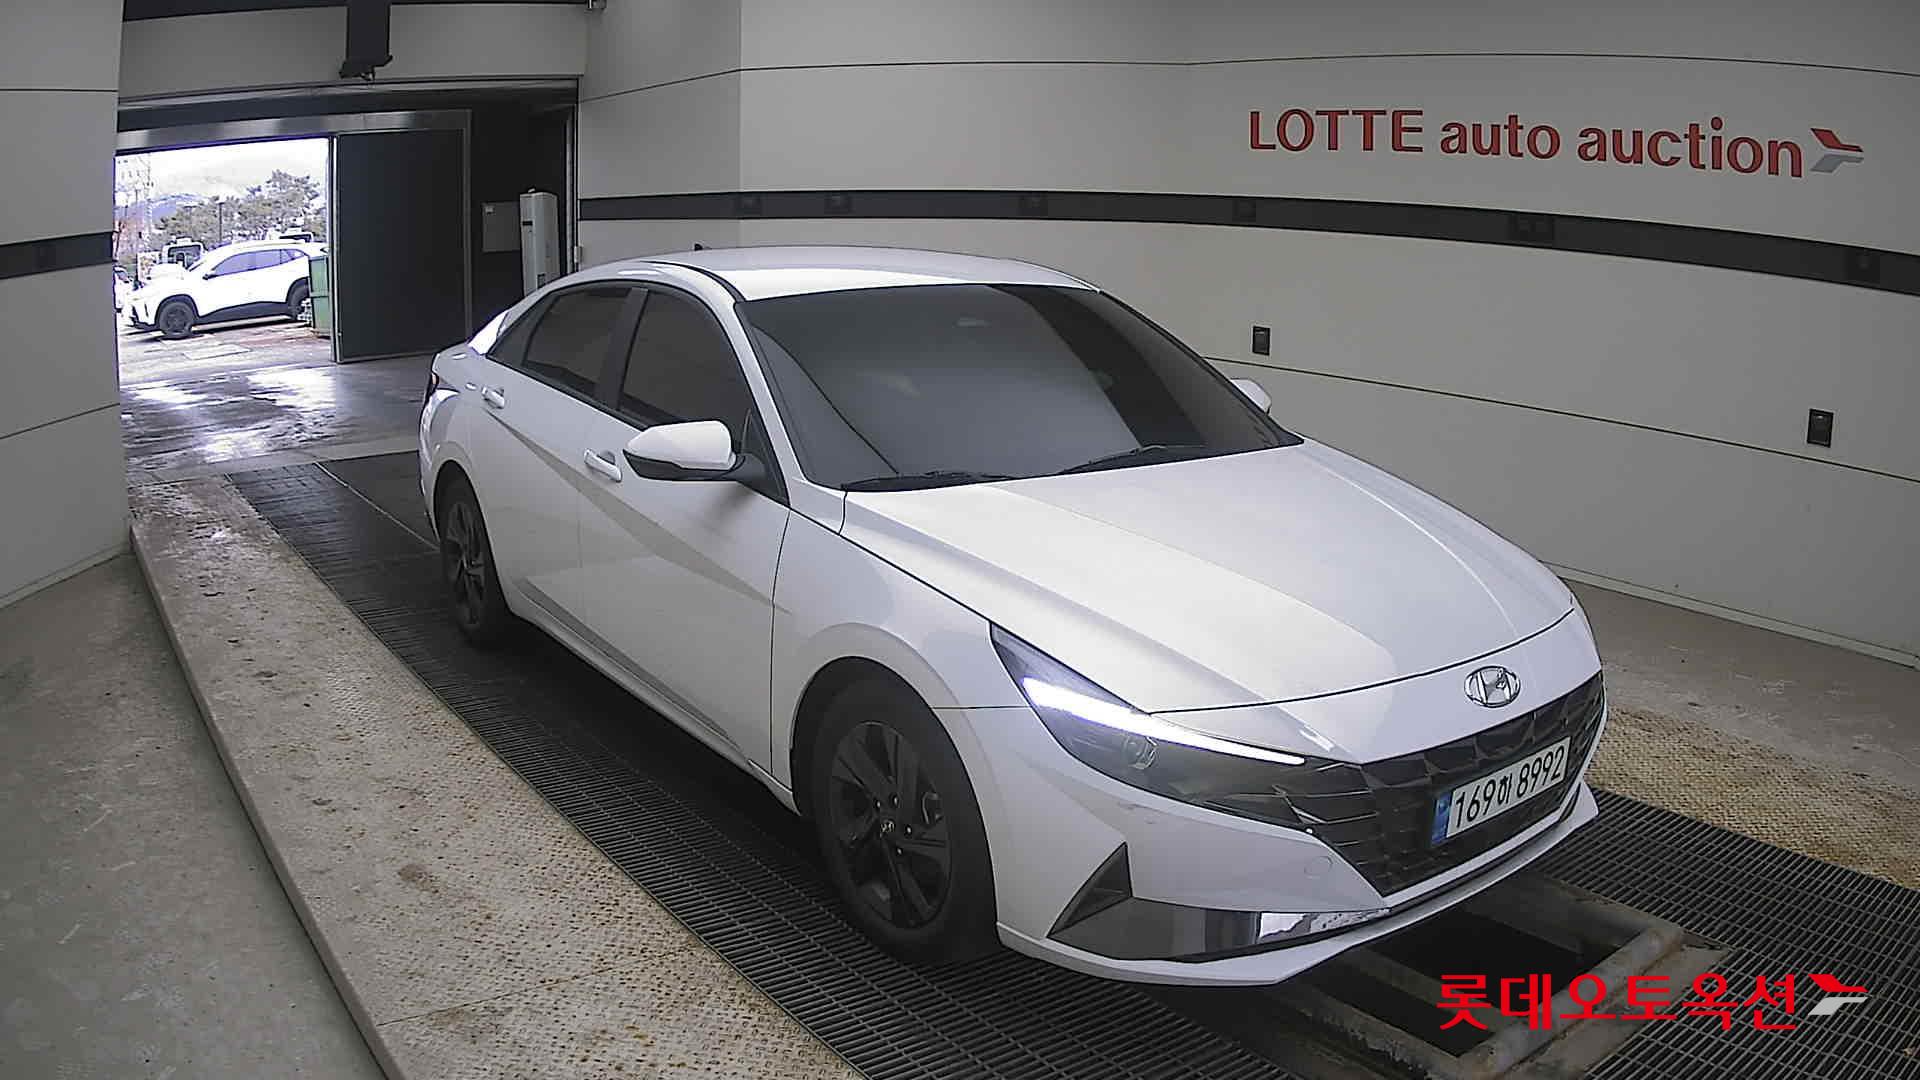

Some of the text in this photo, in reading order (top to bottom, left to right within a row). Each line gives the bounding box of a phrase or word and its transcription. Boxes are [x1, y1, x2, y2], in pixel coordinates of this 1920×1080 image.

[1248, 109, 1803, 178] LOTTE auto auction
[1516, 745, 1566, 799] 8992
